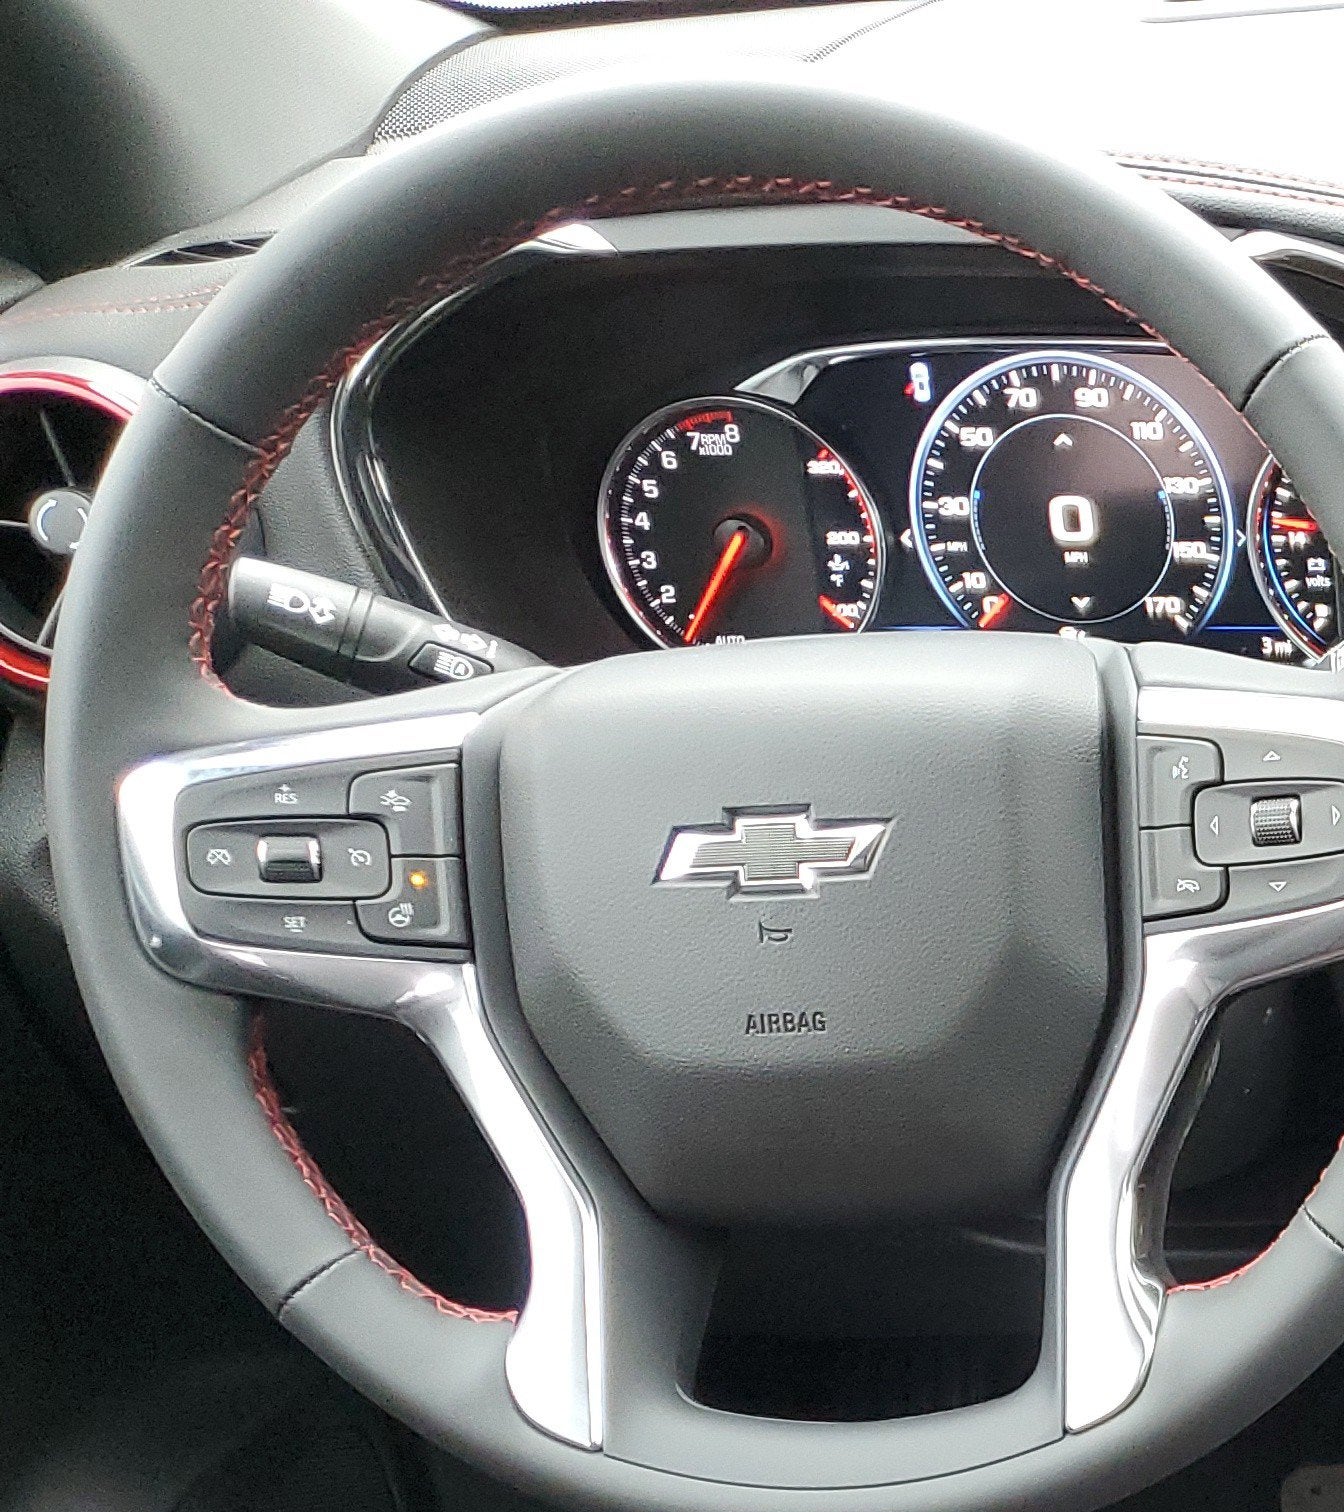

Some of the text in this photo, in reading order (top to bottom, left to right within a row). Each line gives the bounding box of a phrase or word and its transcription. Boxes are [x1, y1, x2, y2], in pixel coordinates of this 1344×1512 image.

[1004, 388, 1037, 408] 70
[1074, 388, 1108, 408] 90
[687, 431, 701, 450] 7
[701, 434, 725, 446] RPM
[724, 423, 740, 443] 8
[959, 427, 993, 447] 50
[1130, 421, 1164, 441] 110
[660, 451, 678, 470] 6
[641, 479, 659, 499] 5
[1163, 476, 1200, 495] 130
[938, 496, 970, 517] 30
[634, 511, 651, 530] 4
[1049, 494, 1096, 542] 0
[826, 530, 860, 546] 200
[1063, 551, 1089, 564] MPH
[1173, 541, 1206, 560] 150
[640, 551, 657, 570] 3
[961, 571, 987, 589] 10
[1305, 574, 1332, 588] volts
[660, 585, 677, 604] 2
[1144, 596, 1182, 614] 170
[1261, 637, 1293, 654] 3 mi
[274, 793, 298, 805] RES
[744, 1012, 827, 1035] AIRBAG
